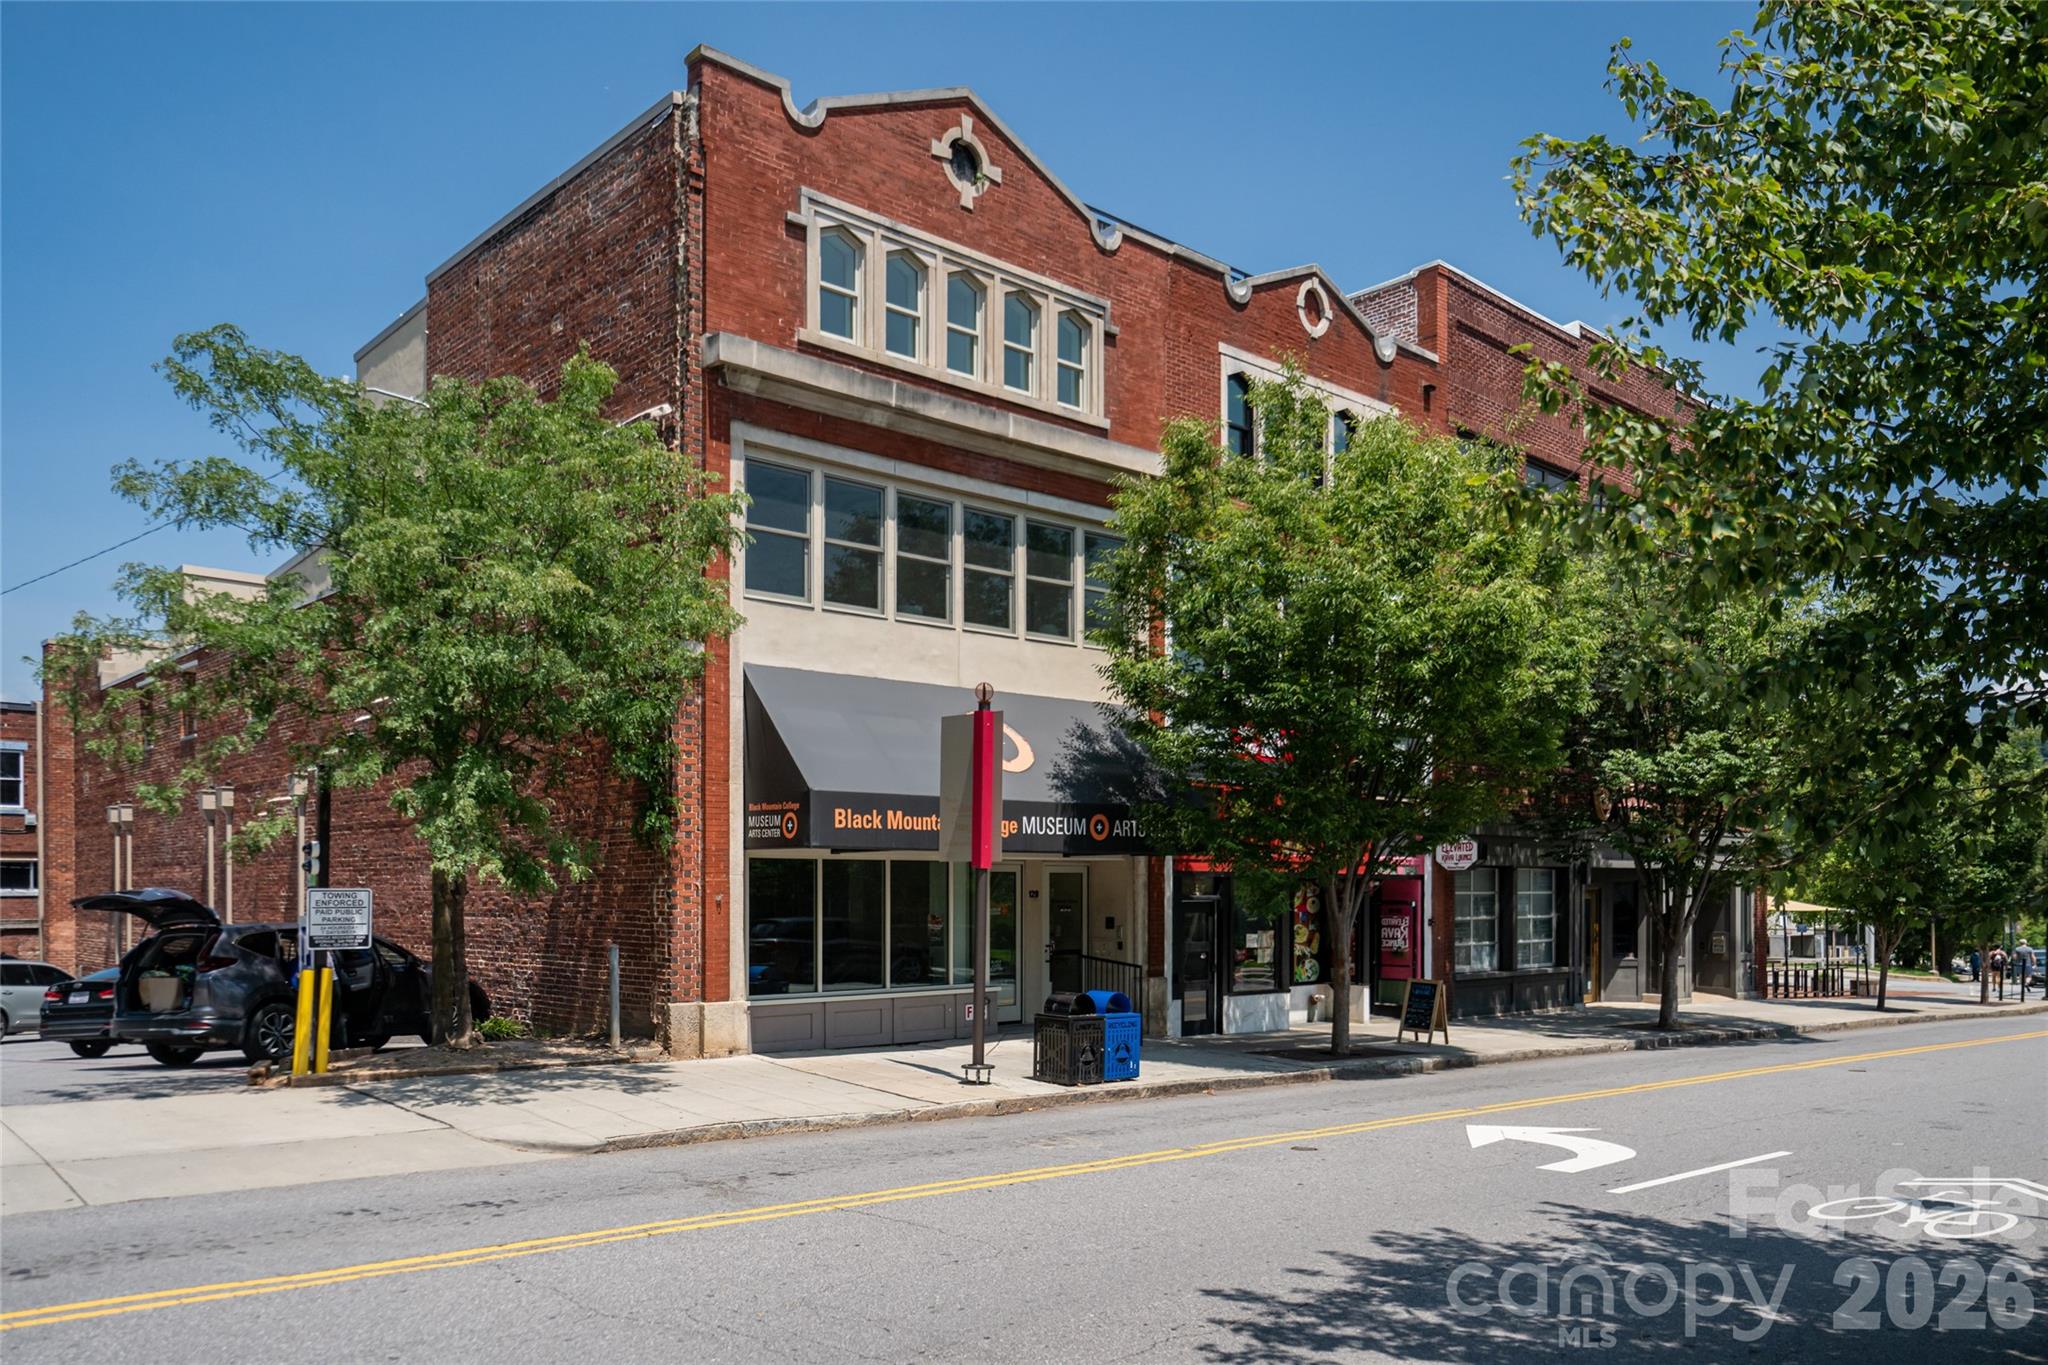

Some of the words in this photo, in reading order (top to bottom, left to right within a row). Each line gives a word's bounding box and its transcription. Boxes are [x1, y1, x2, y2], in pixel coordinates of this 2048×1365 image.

[748, 815, 781, 827] MUSEUM
[834, 808, 883, 830] Black
[1022, 816, 1087, 835] MUSEUM
[748, 829, 761, 838] ARTS
[761, 828, 781, 838] CENTER
